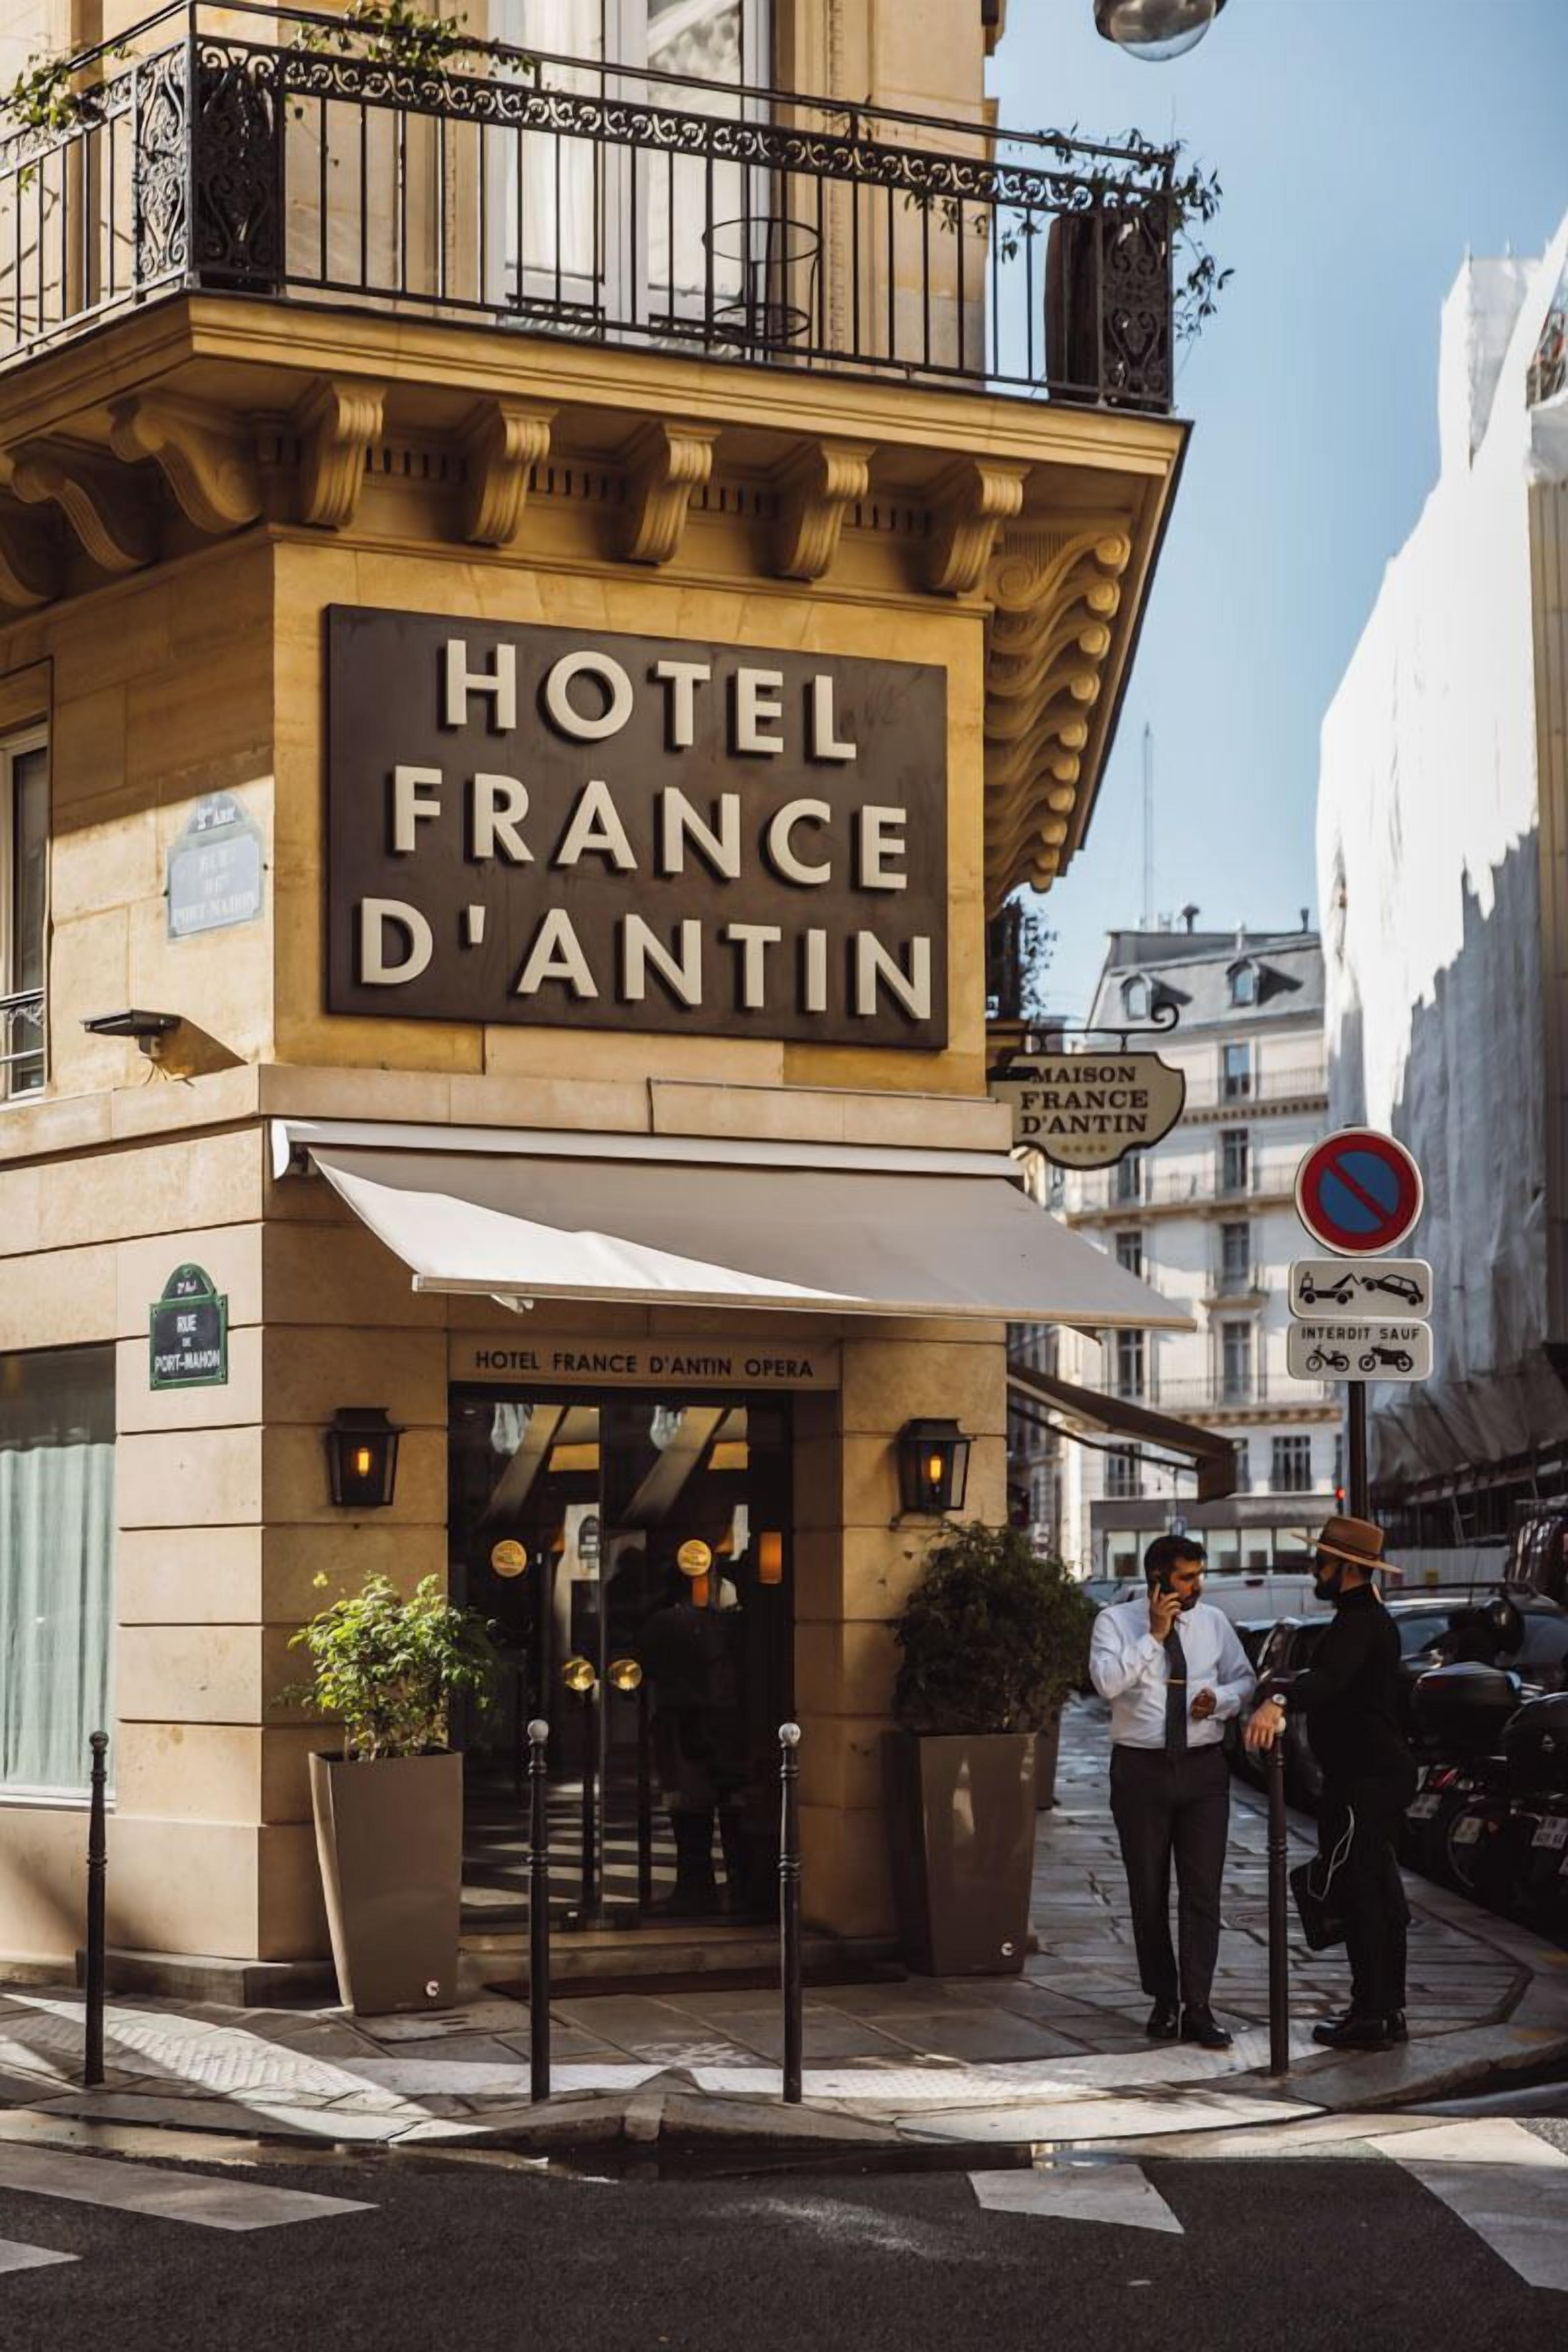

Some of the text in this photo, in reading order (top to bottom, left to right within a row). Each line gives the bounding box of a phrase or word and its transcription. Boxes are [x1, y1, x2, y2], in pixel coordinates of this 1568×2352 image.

[446, 639, 858, 760] HOTEL
[394, 764, 907, 890] FRANCE
[360, 897, 932, 1020] D'ANTIN
[1032, 1066, 1136, 1083] MAISON
[1021, 1090, 1149, 1110] FRANCE
[1021, 1114, 1147, 1134] D'ANTIN
[1301, 1326, 1420, 1341] INTERDIT SAUF
[475, 1350, 814, 1378] HOTEL FRANCE D'ANTIN OPERA
